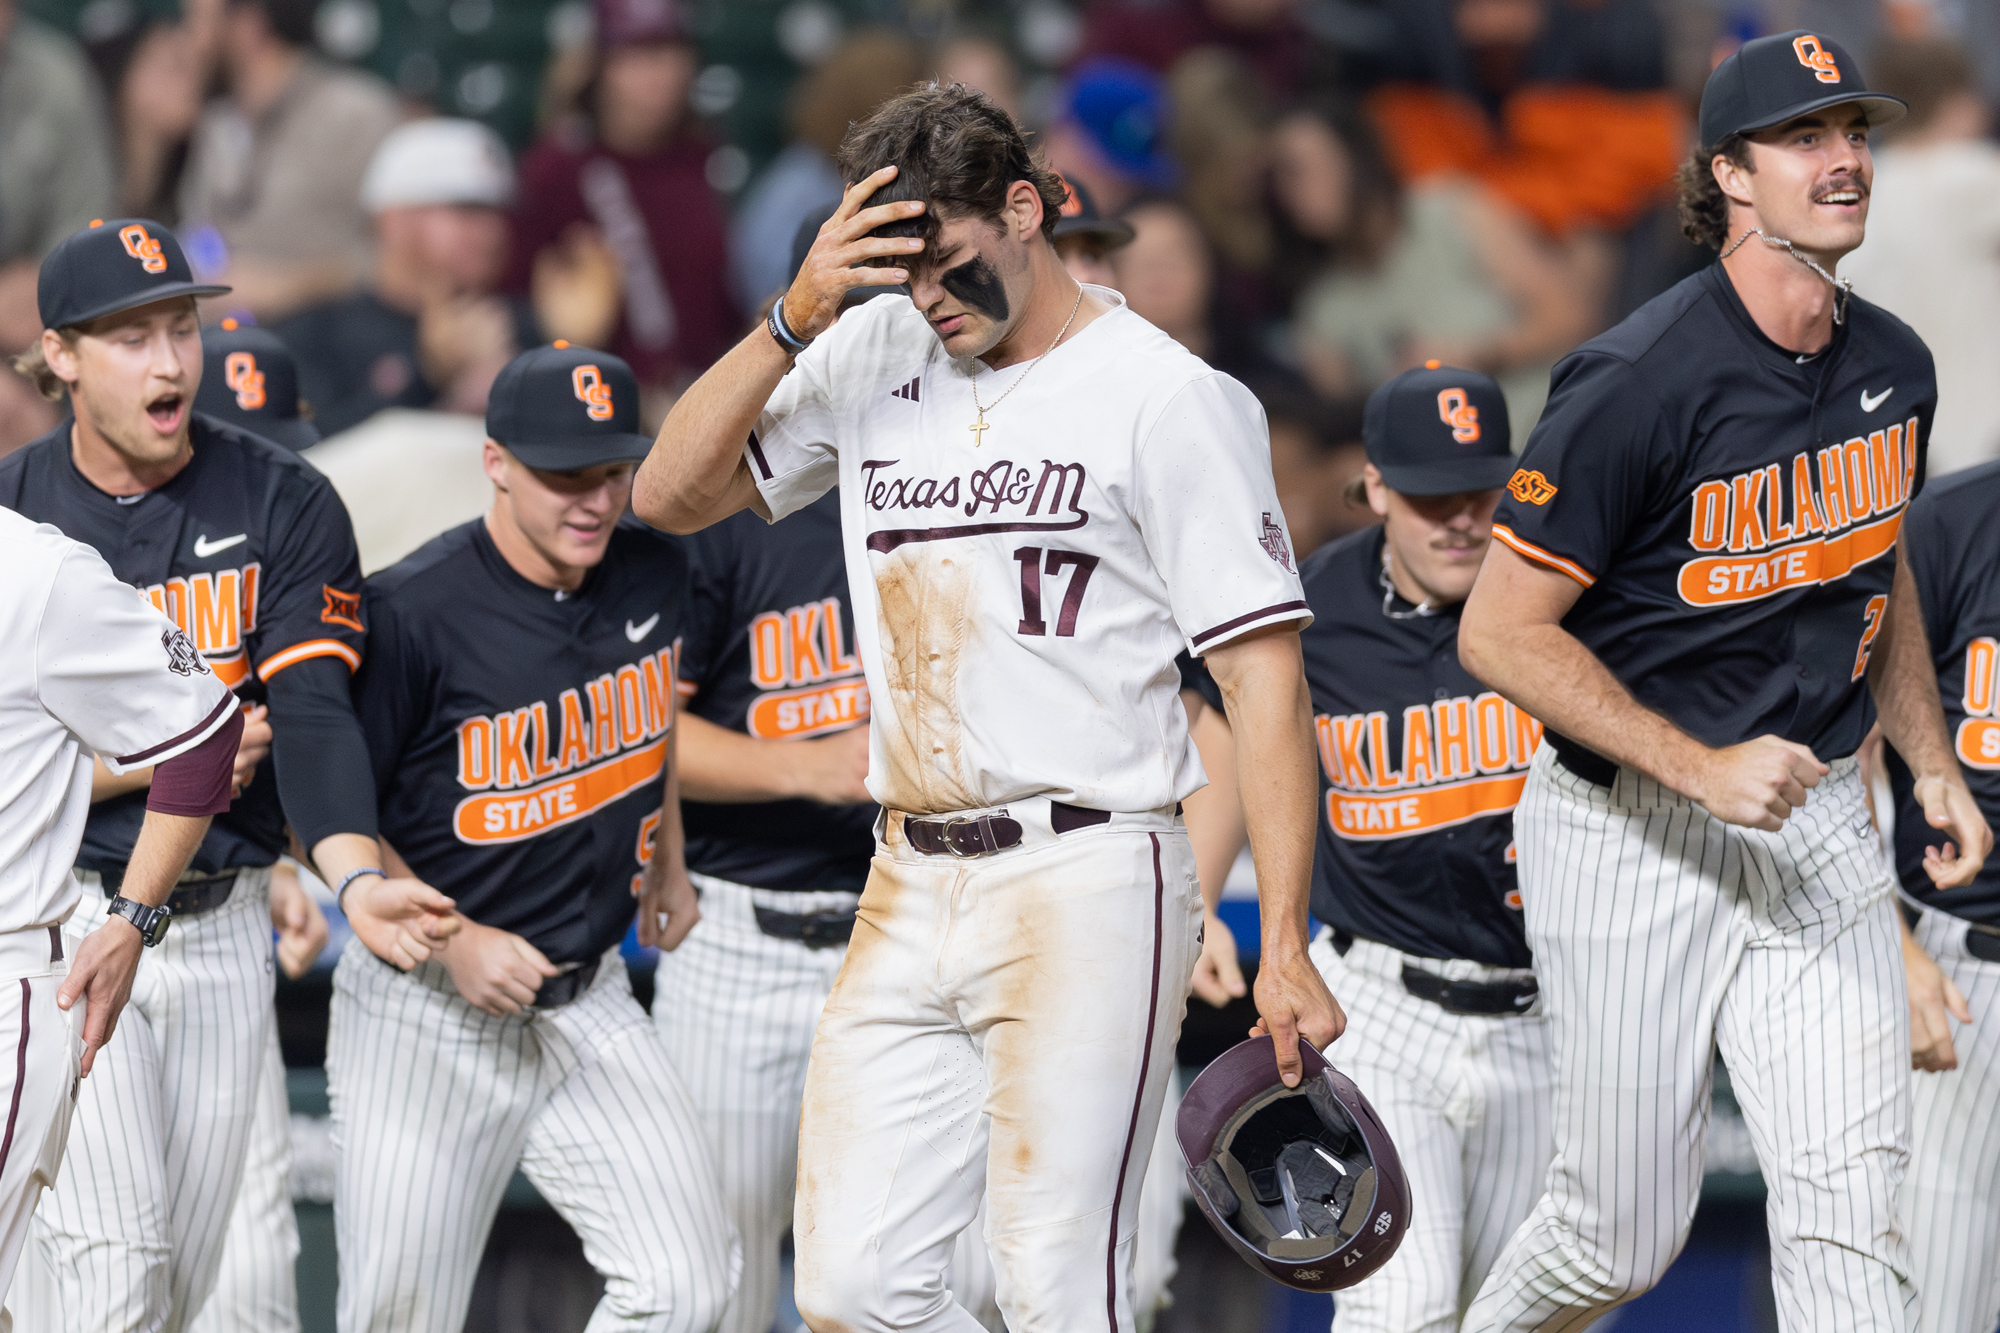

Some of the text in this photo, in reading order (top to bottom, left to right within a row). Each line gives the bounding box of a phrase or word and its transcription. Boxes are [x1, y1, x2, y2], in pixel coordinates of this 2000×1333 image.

[861, 459, 1089, 523] Texas A&M
[1687, 416, 1918, 553] OKLAHOMA
[1013, 546, 1100, 637] 17
[1707, 551, 1807, 595] STATE
[457, 636, 683, 790] OKLAHOM
[484, 782, 578, 833] STATE
[1338, 797, 1420, 831] STATE
[1343, 1210, 1393, 1268] SEC 17
